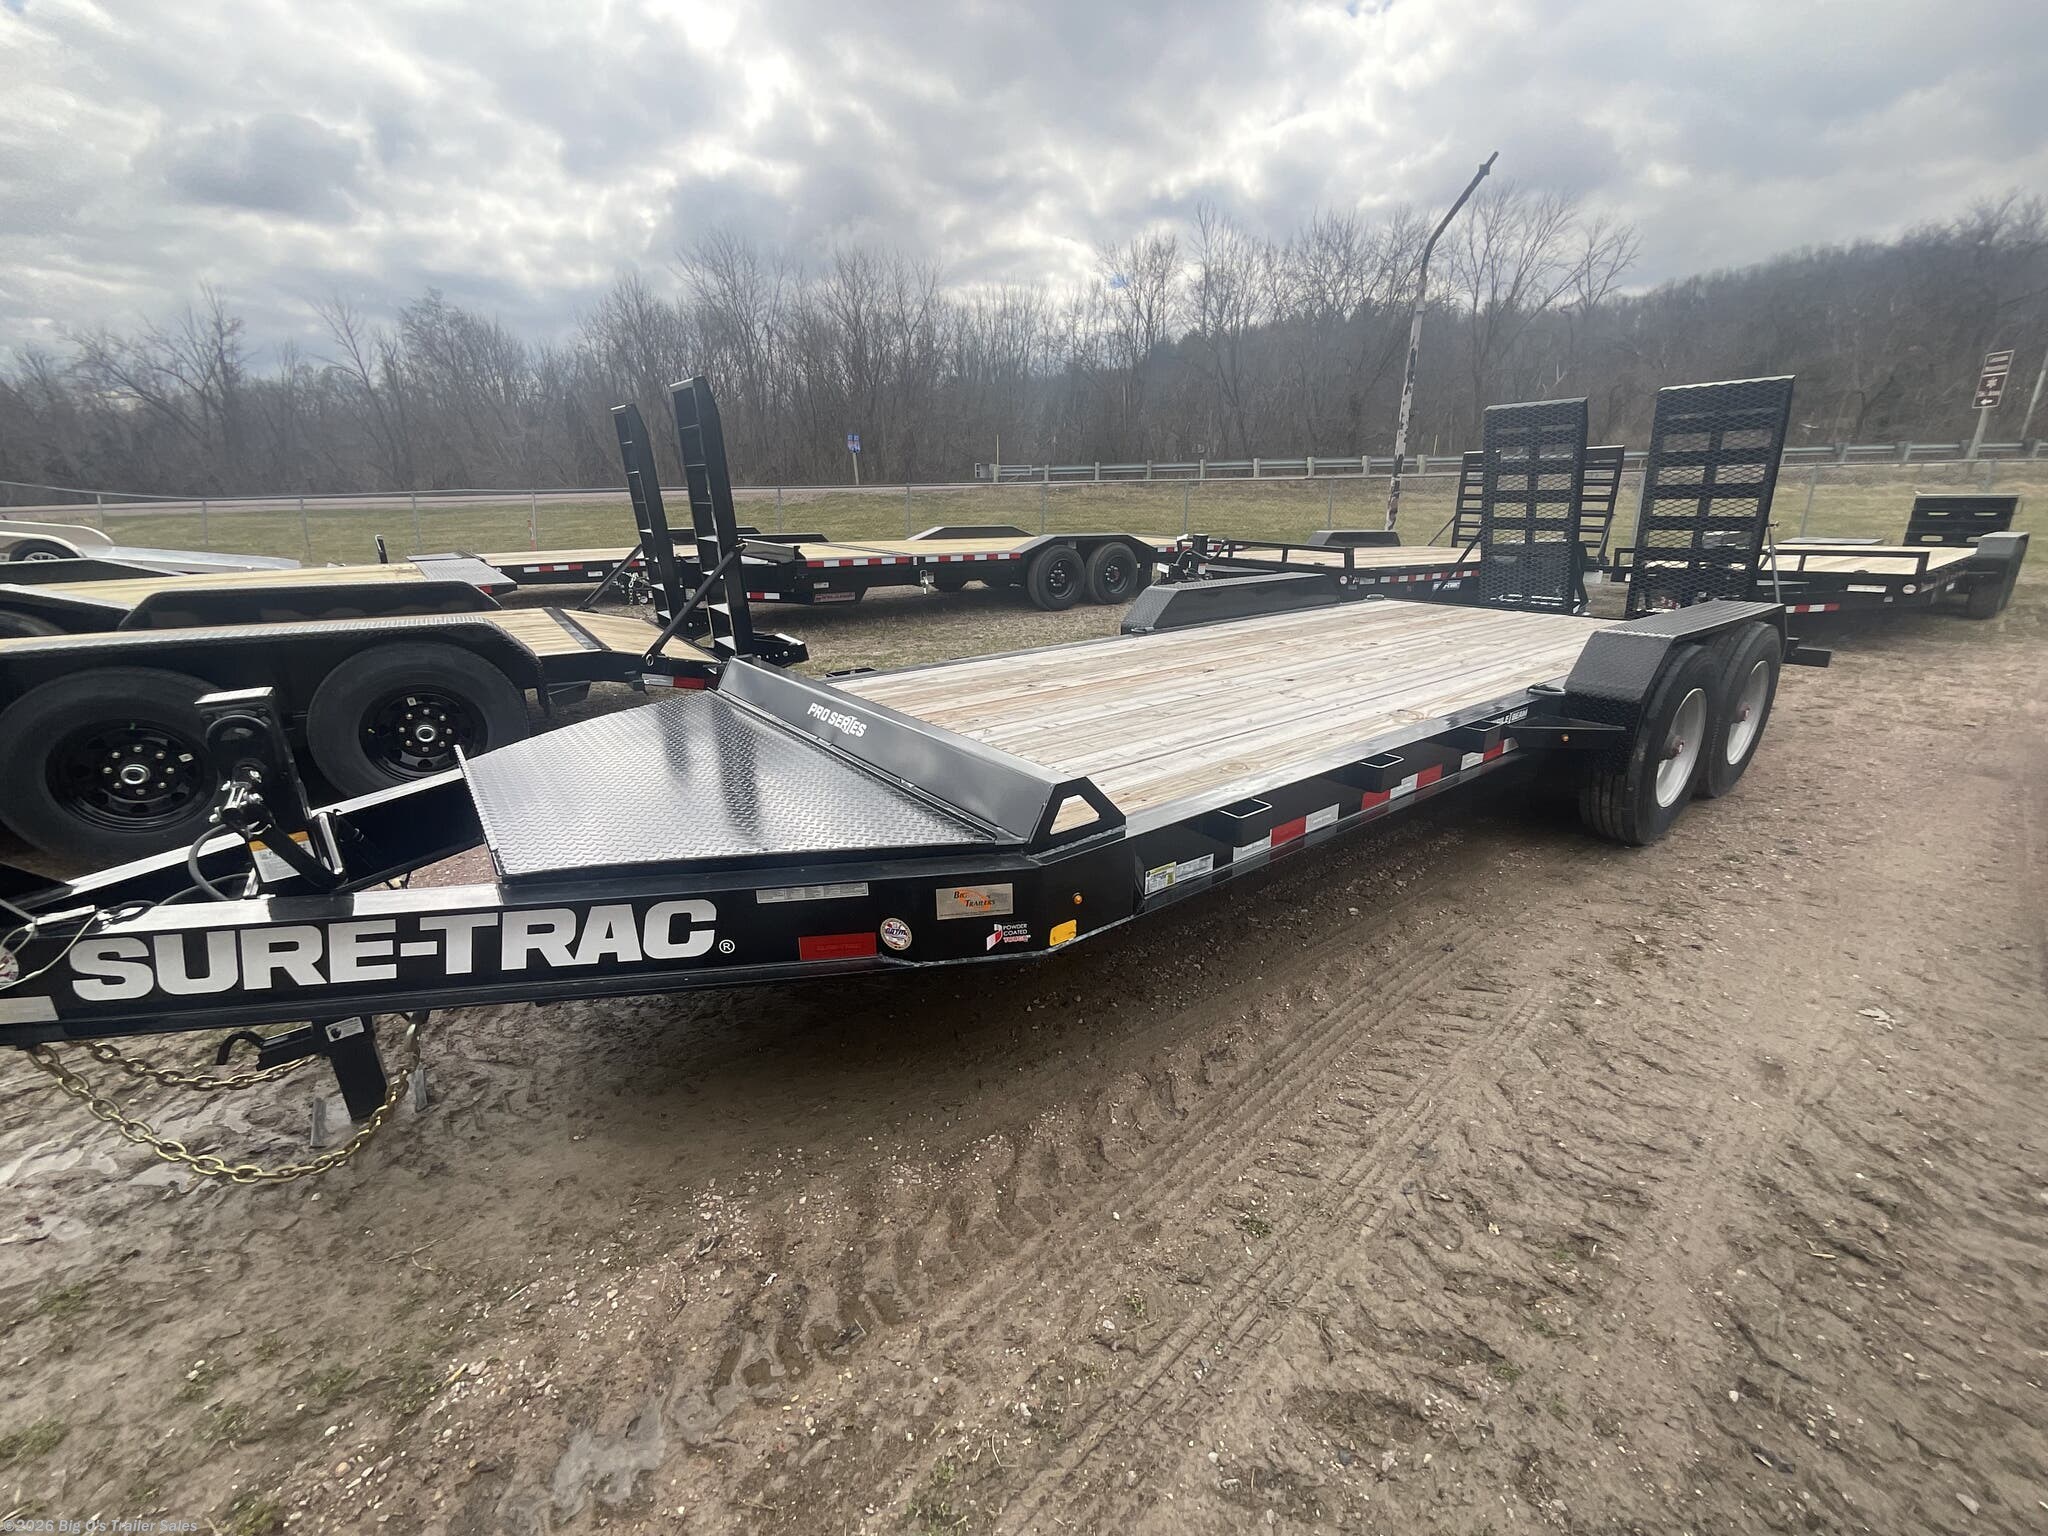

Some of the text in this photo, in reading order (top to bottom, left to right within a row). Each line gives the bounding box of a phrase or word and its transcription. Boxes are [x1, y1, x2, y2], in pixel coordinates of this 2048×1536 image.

[807, 702, 867, 737] PRO SERIES
[1003, 923, 1028, 931] POWDER
[1003, 929, 1028, 937] COATED
[69, 899, 716, 1001] SURE-TRAC
